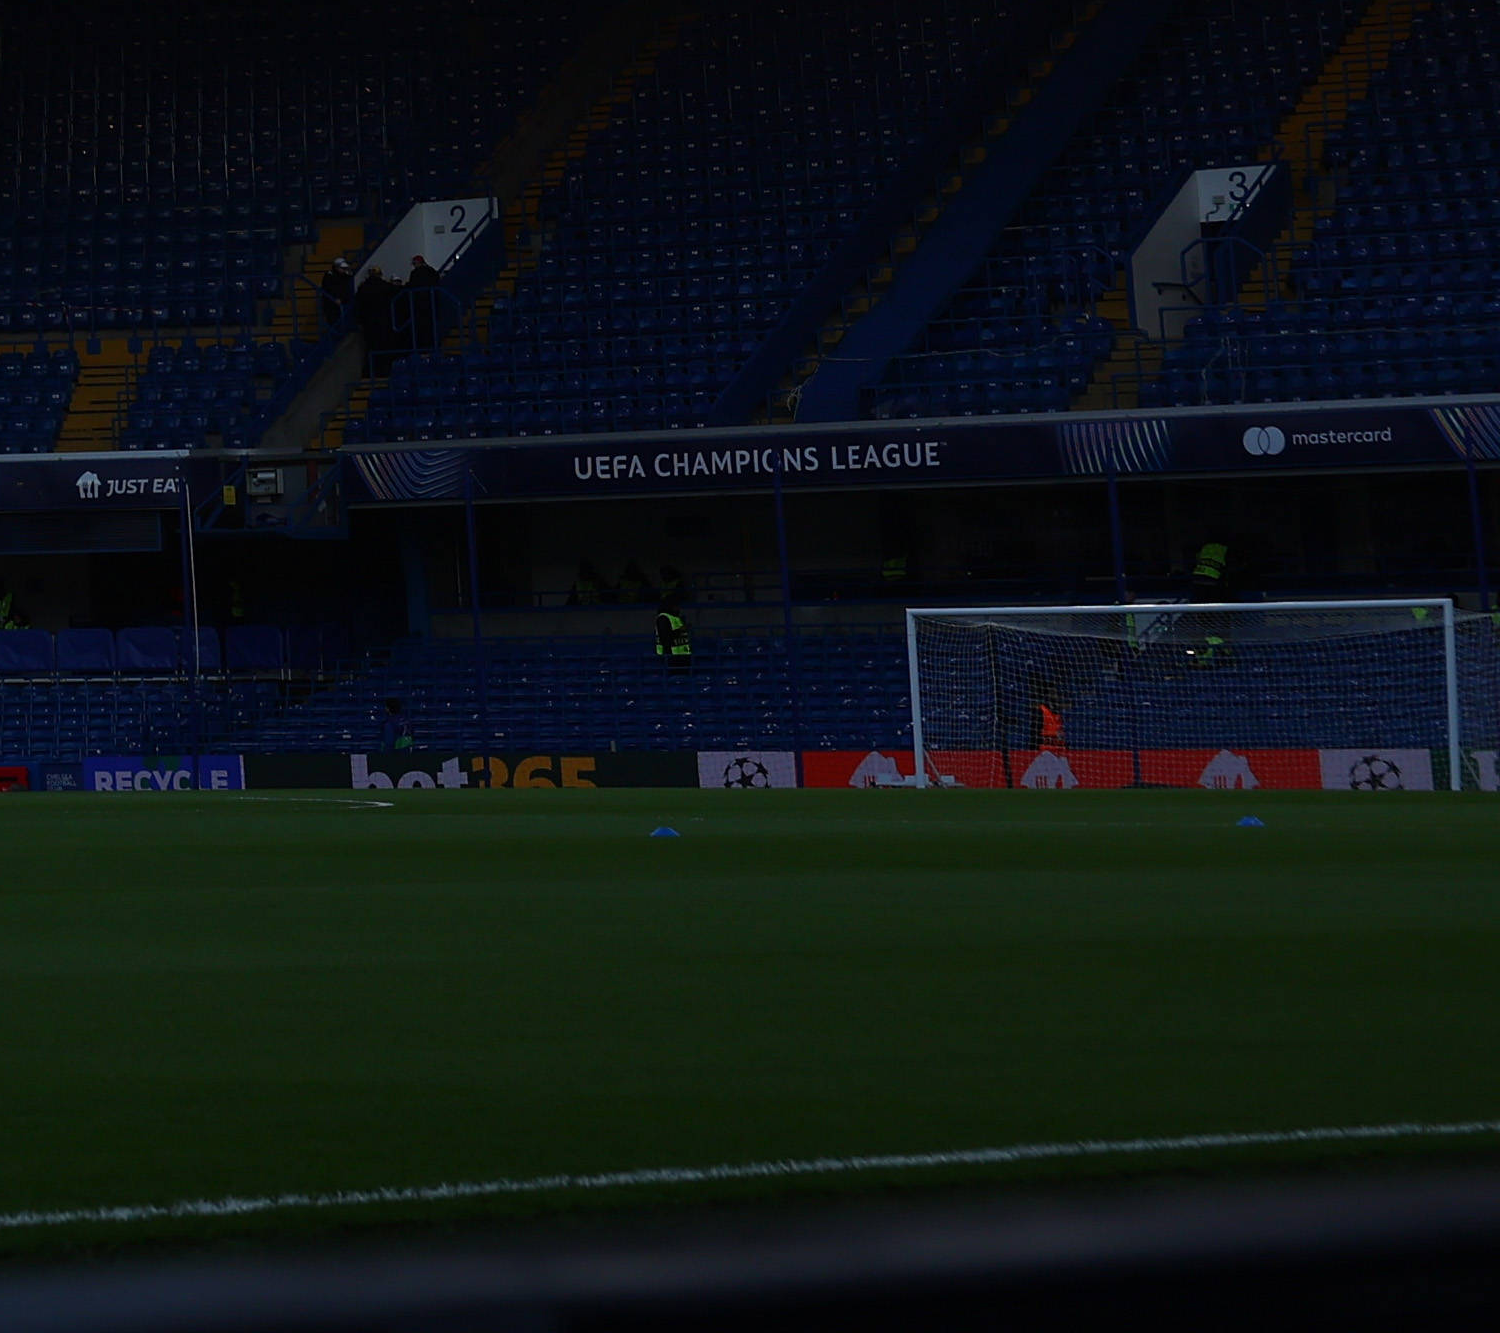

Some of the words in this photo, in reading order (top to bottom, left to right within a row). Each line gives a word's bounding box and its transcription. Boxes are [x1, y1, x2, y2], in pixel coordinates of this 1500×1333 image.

[1229, 172, 1247, 203] 3
[450, 205, 466, 232] 2
[1292, 427, 1392, 445] mastercard
[574, 454, 646, 480] UEFA
[654, 445, 819, 477] CHAMPIONS
[106, 478, 148, 497] JUST
[95, 769, 228, 791] RECYCE
